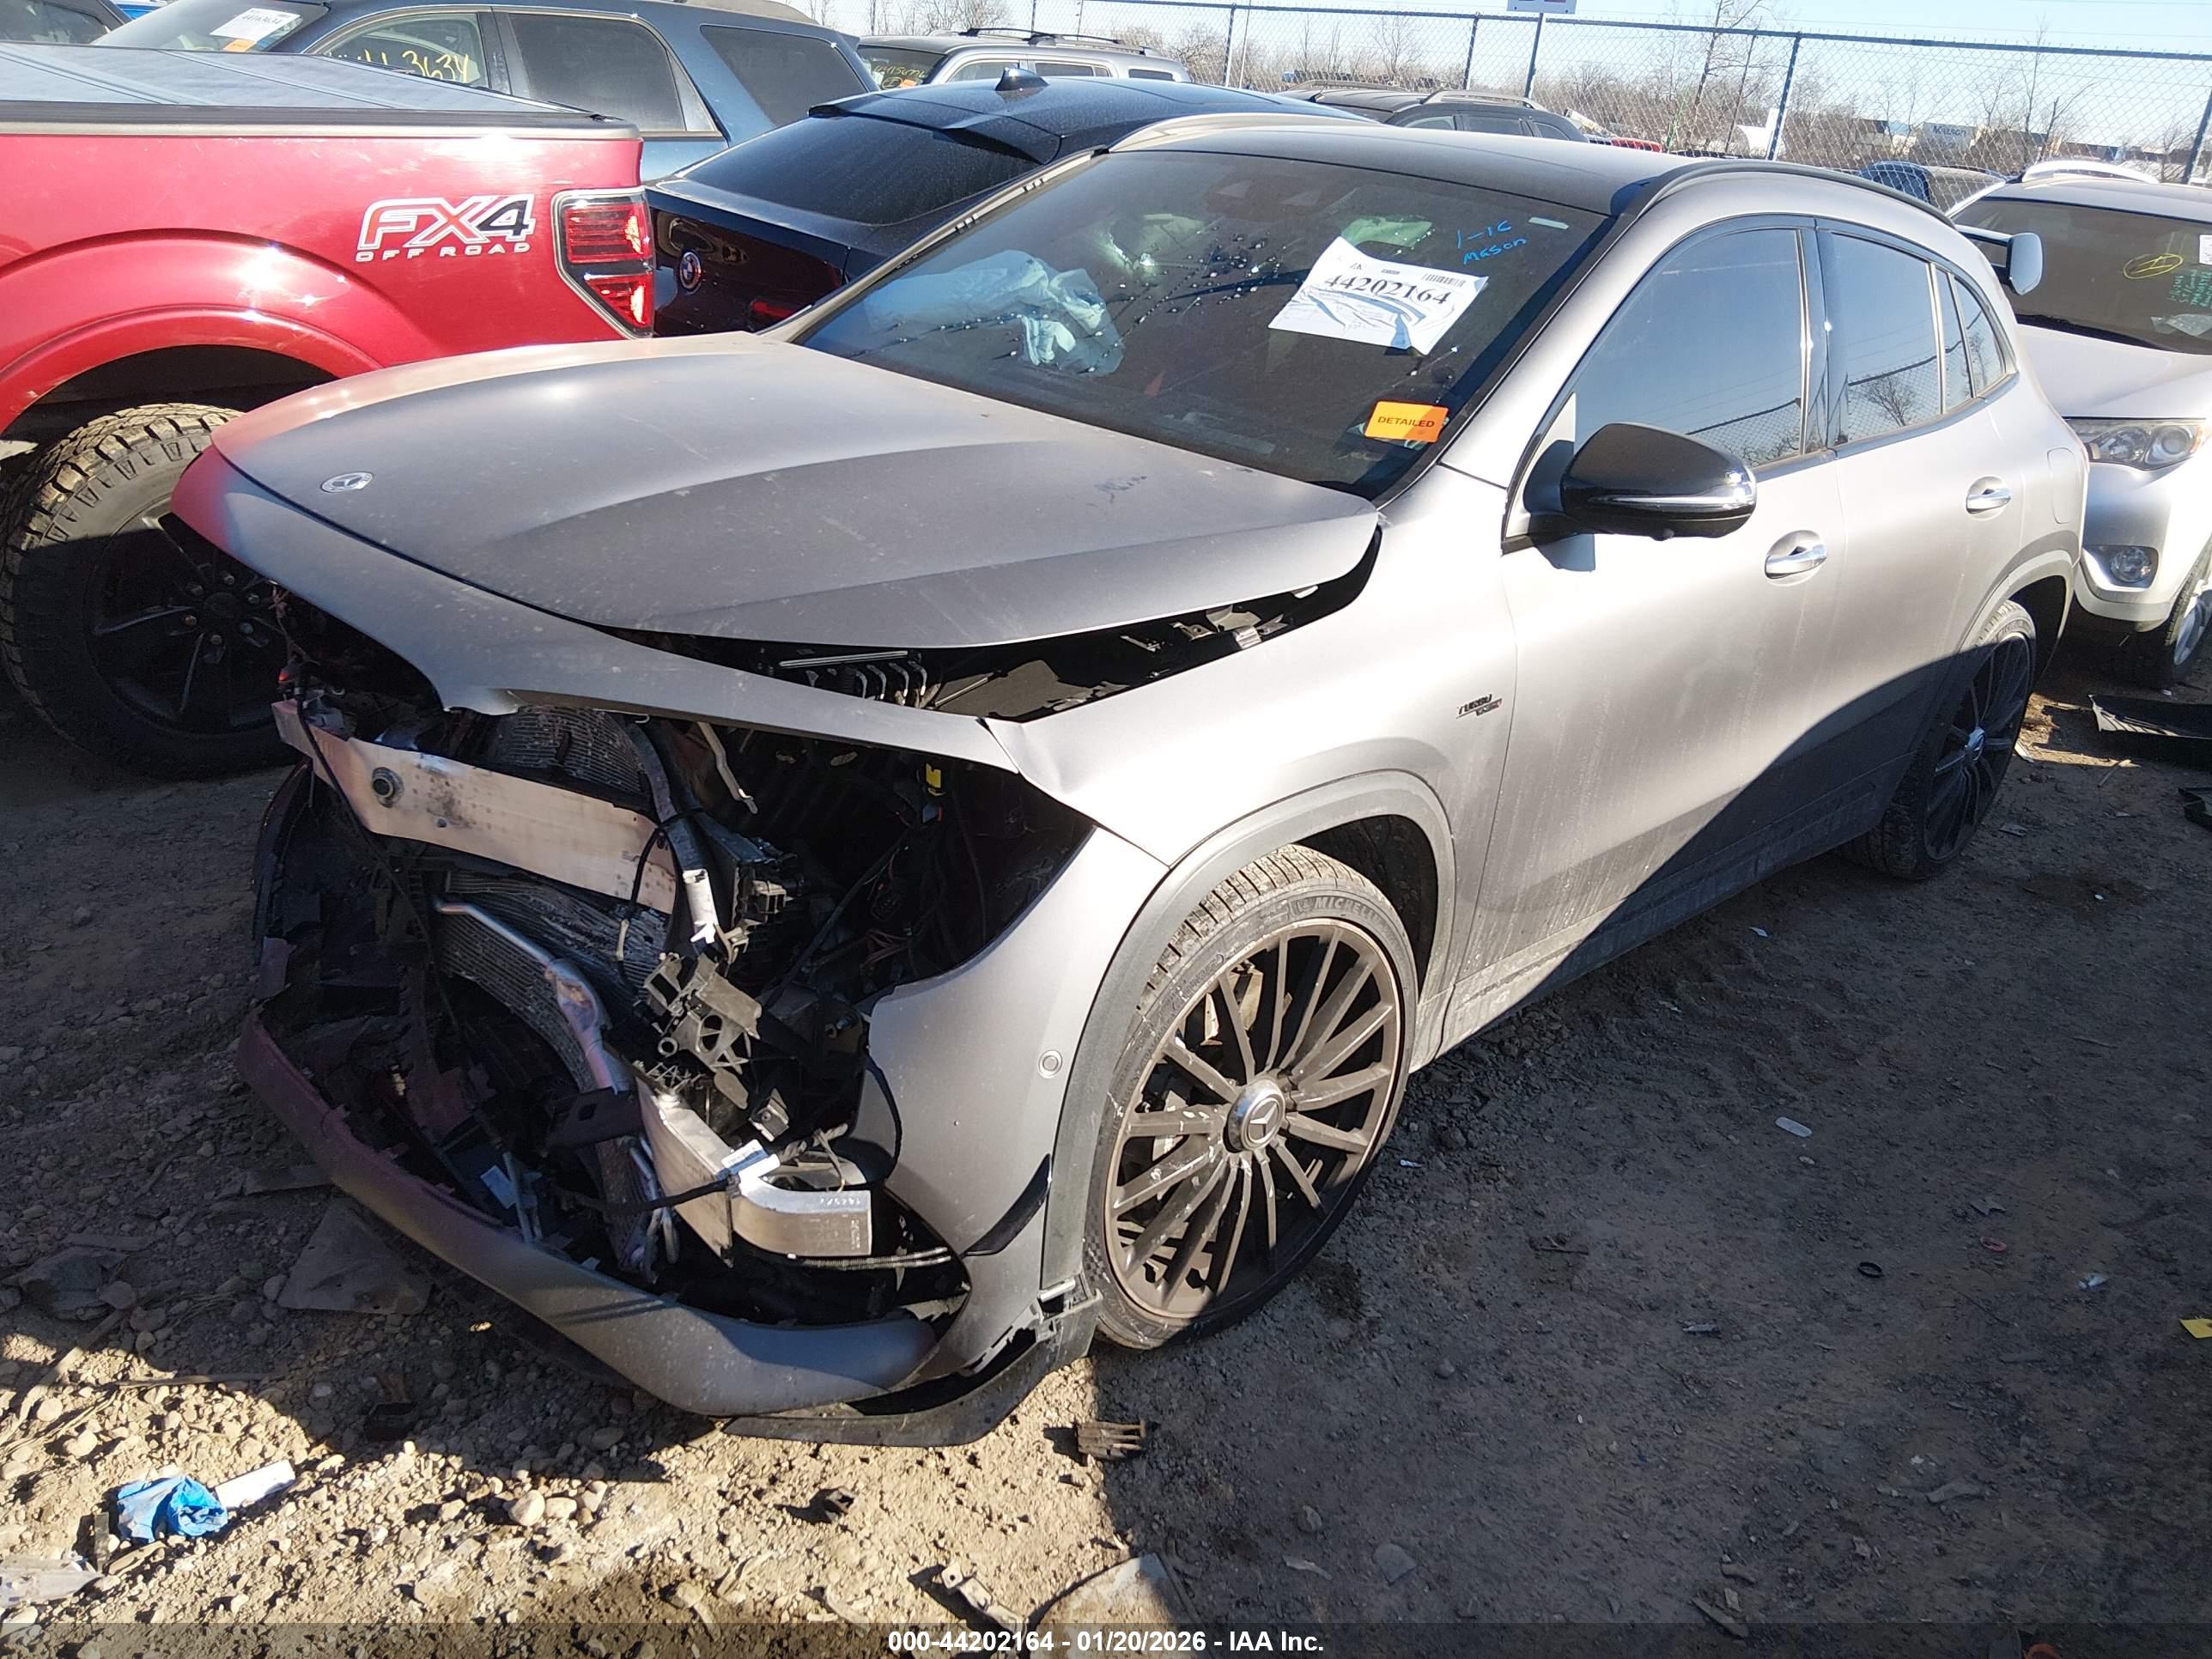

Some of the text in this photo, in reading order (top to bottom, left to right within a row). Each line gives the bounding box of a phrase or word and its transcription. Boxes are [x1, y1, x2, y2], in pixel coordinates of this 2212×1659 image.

[357, 193, 536, 251] FX4
[356, 242, 531, 262] OFF ROAD
[1323, 273, 1452, 305] 44202164
[1377, 416, 1435, 428] DETAILED
